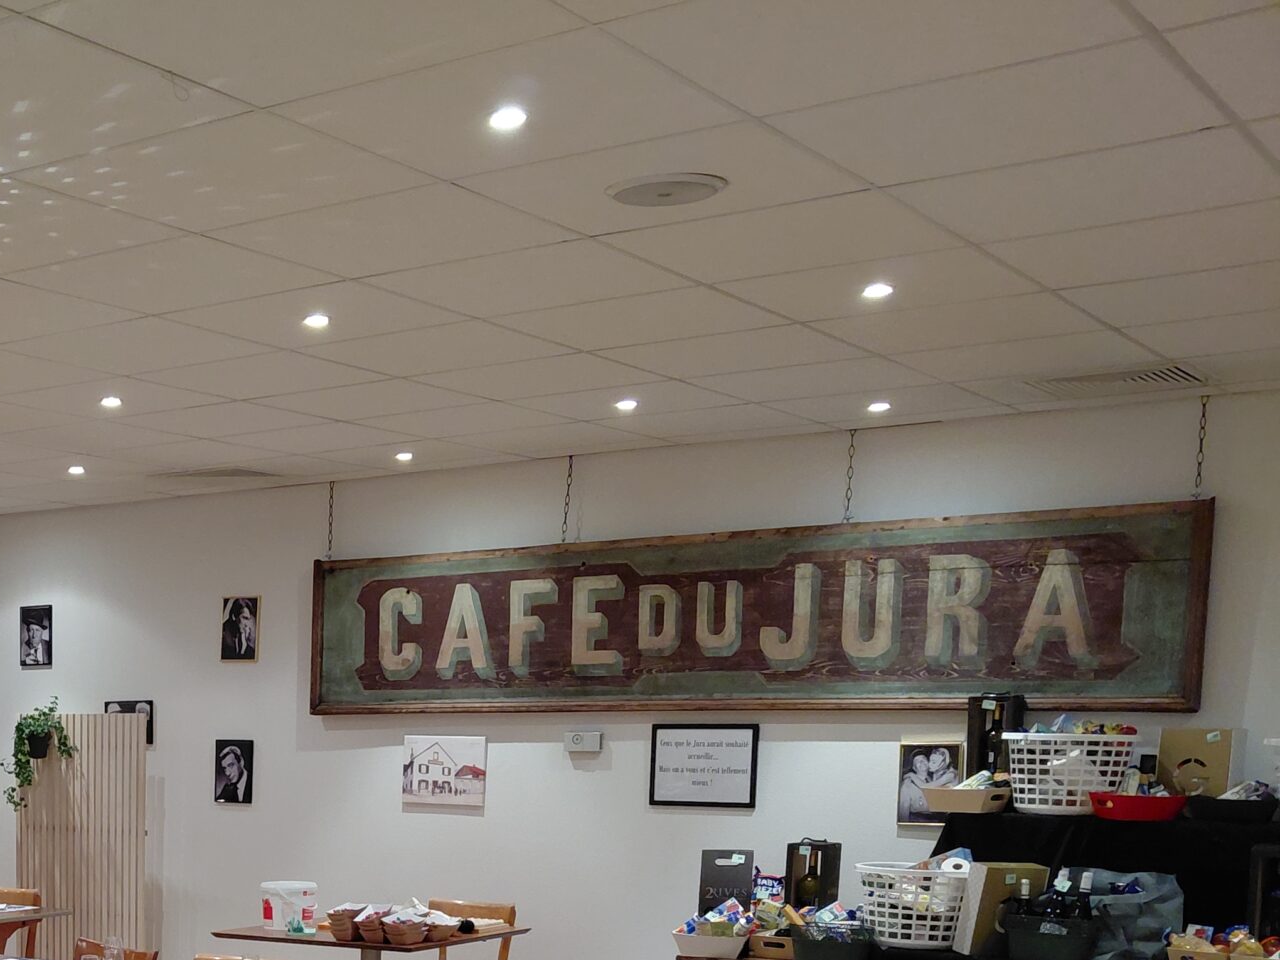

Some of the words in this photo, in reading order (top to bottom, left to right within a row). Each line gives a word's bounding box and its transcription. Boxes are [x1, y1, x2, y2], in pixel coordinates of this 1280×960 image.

[378, 574, 625, 681] CAFE
[637, 578, 744, 658] DU
[760, 548, 1099, 673] JURA
[674, 740, 685, 750] que
[693, 739, 706, 749] Jura
[706, 740, 724, 749] aurait
[706, 766, 720, 775] c'est
[721, 766, 748, 775] tellement
[691, 779, 709, 787] mieux
[756, 877, 780, 888] BABY
